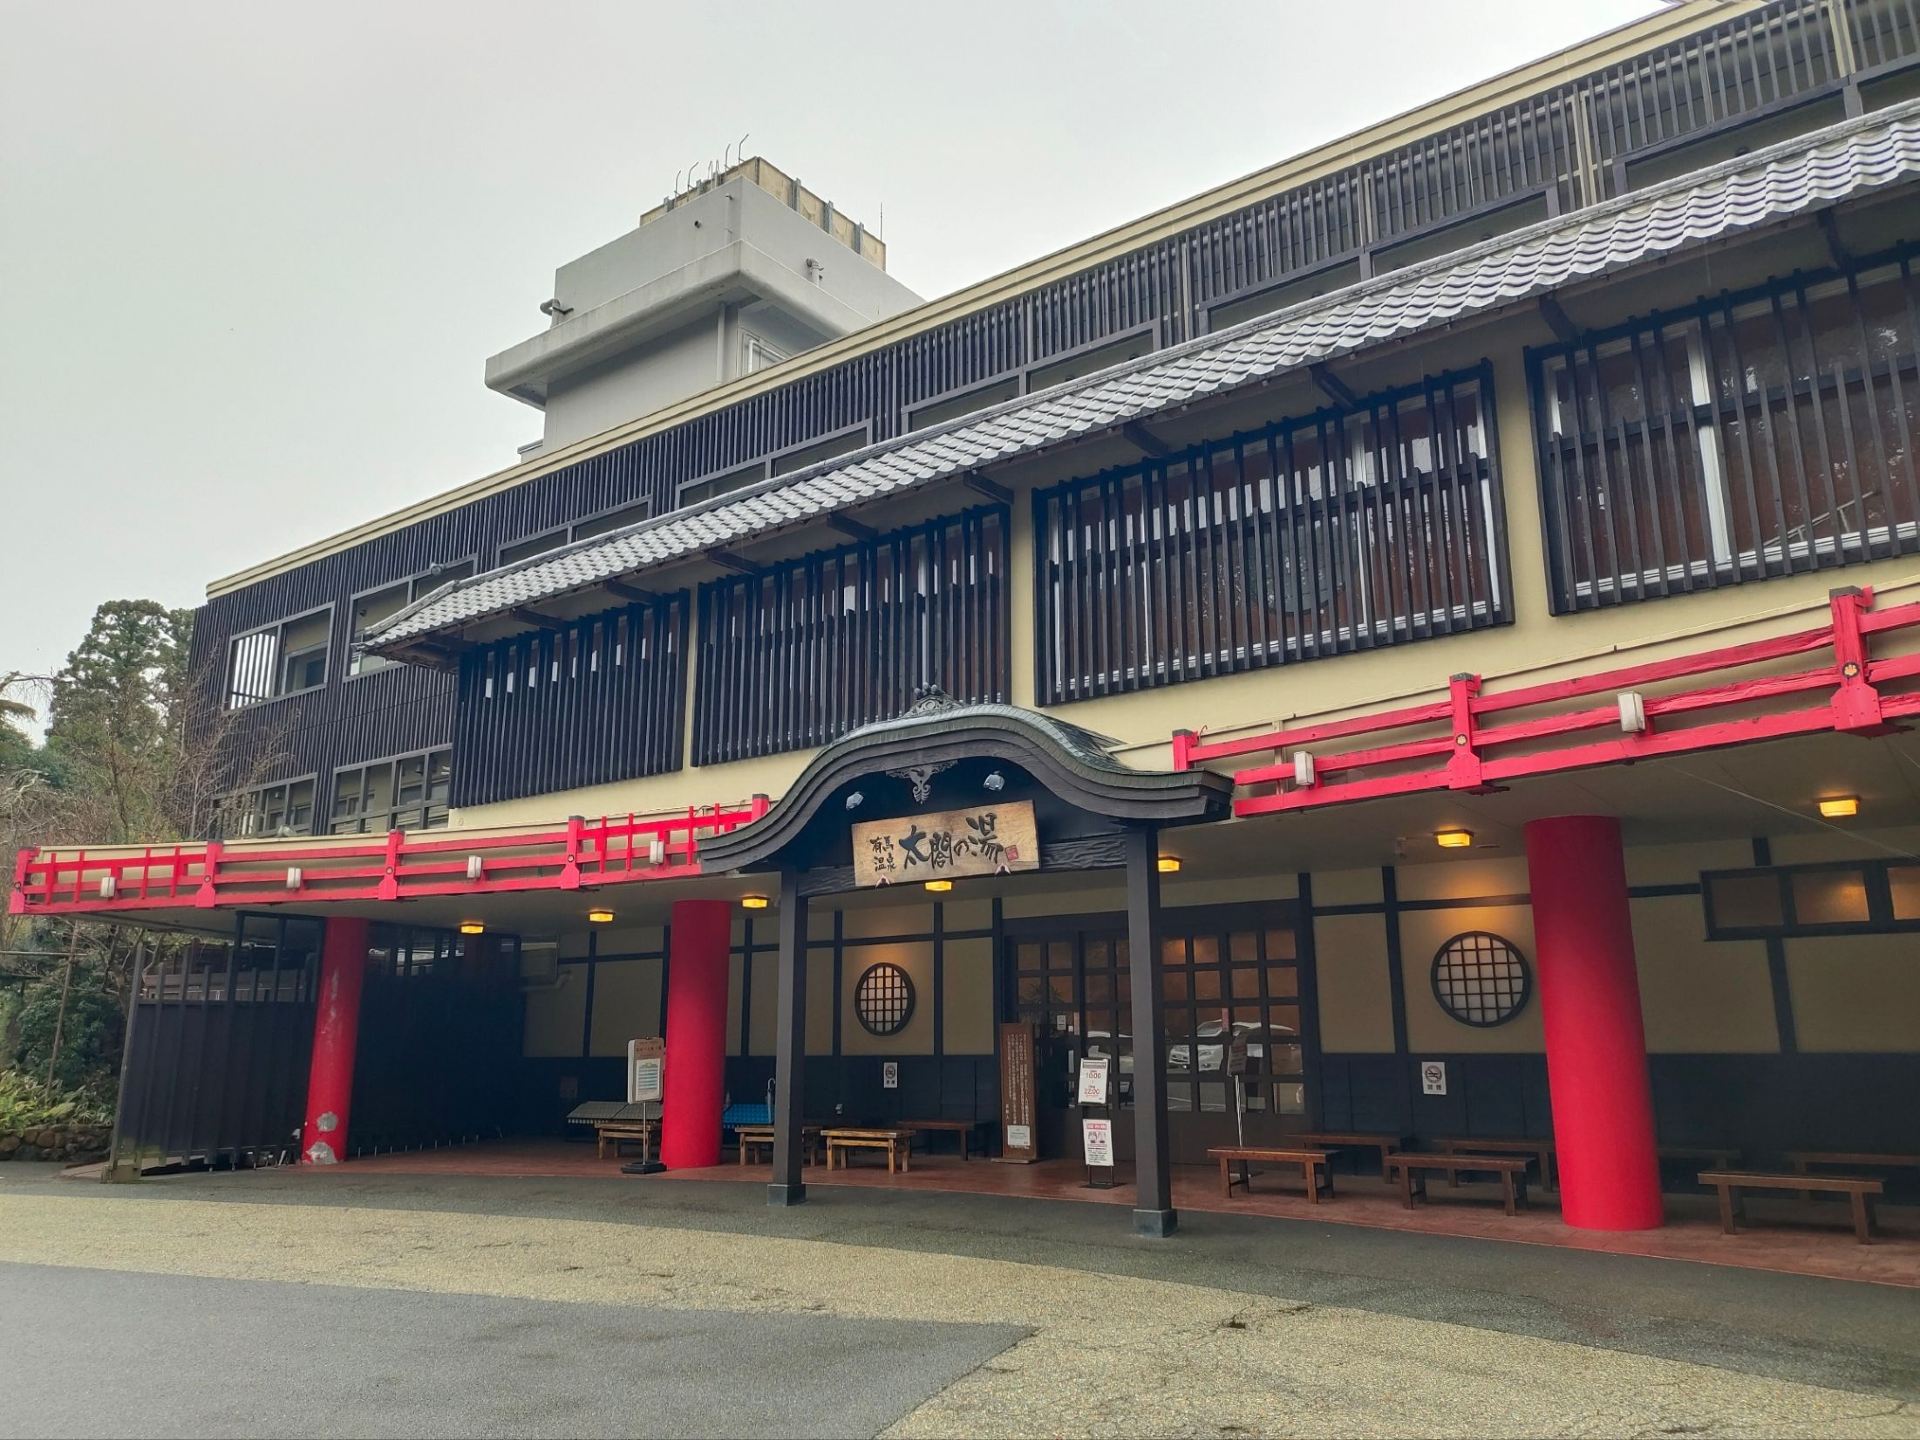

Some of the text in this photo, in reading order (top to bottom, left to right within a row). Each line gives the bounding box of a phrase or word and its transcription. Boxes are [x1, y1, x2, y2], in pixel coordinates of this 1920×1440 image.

[869, 835, 894, 854] 有馬
[898, 812, 1004, 870] 太閤の湯
[873, 852, 897, 872] 温泉
